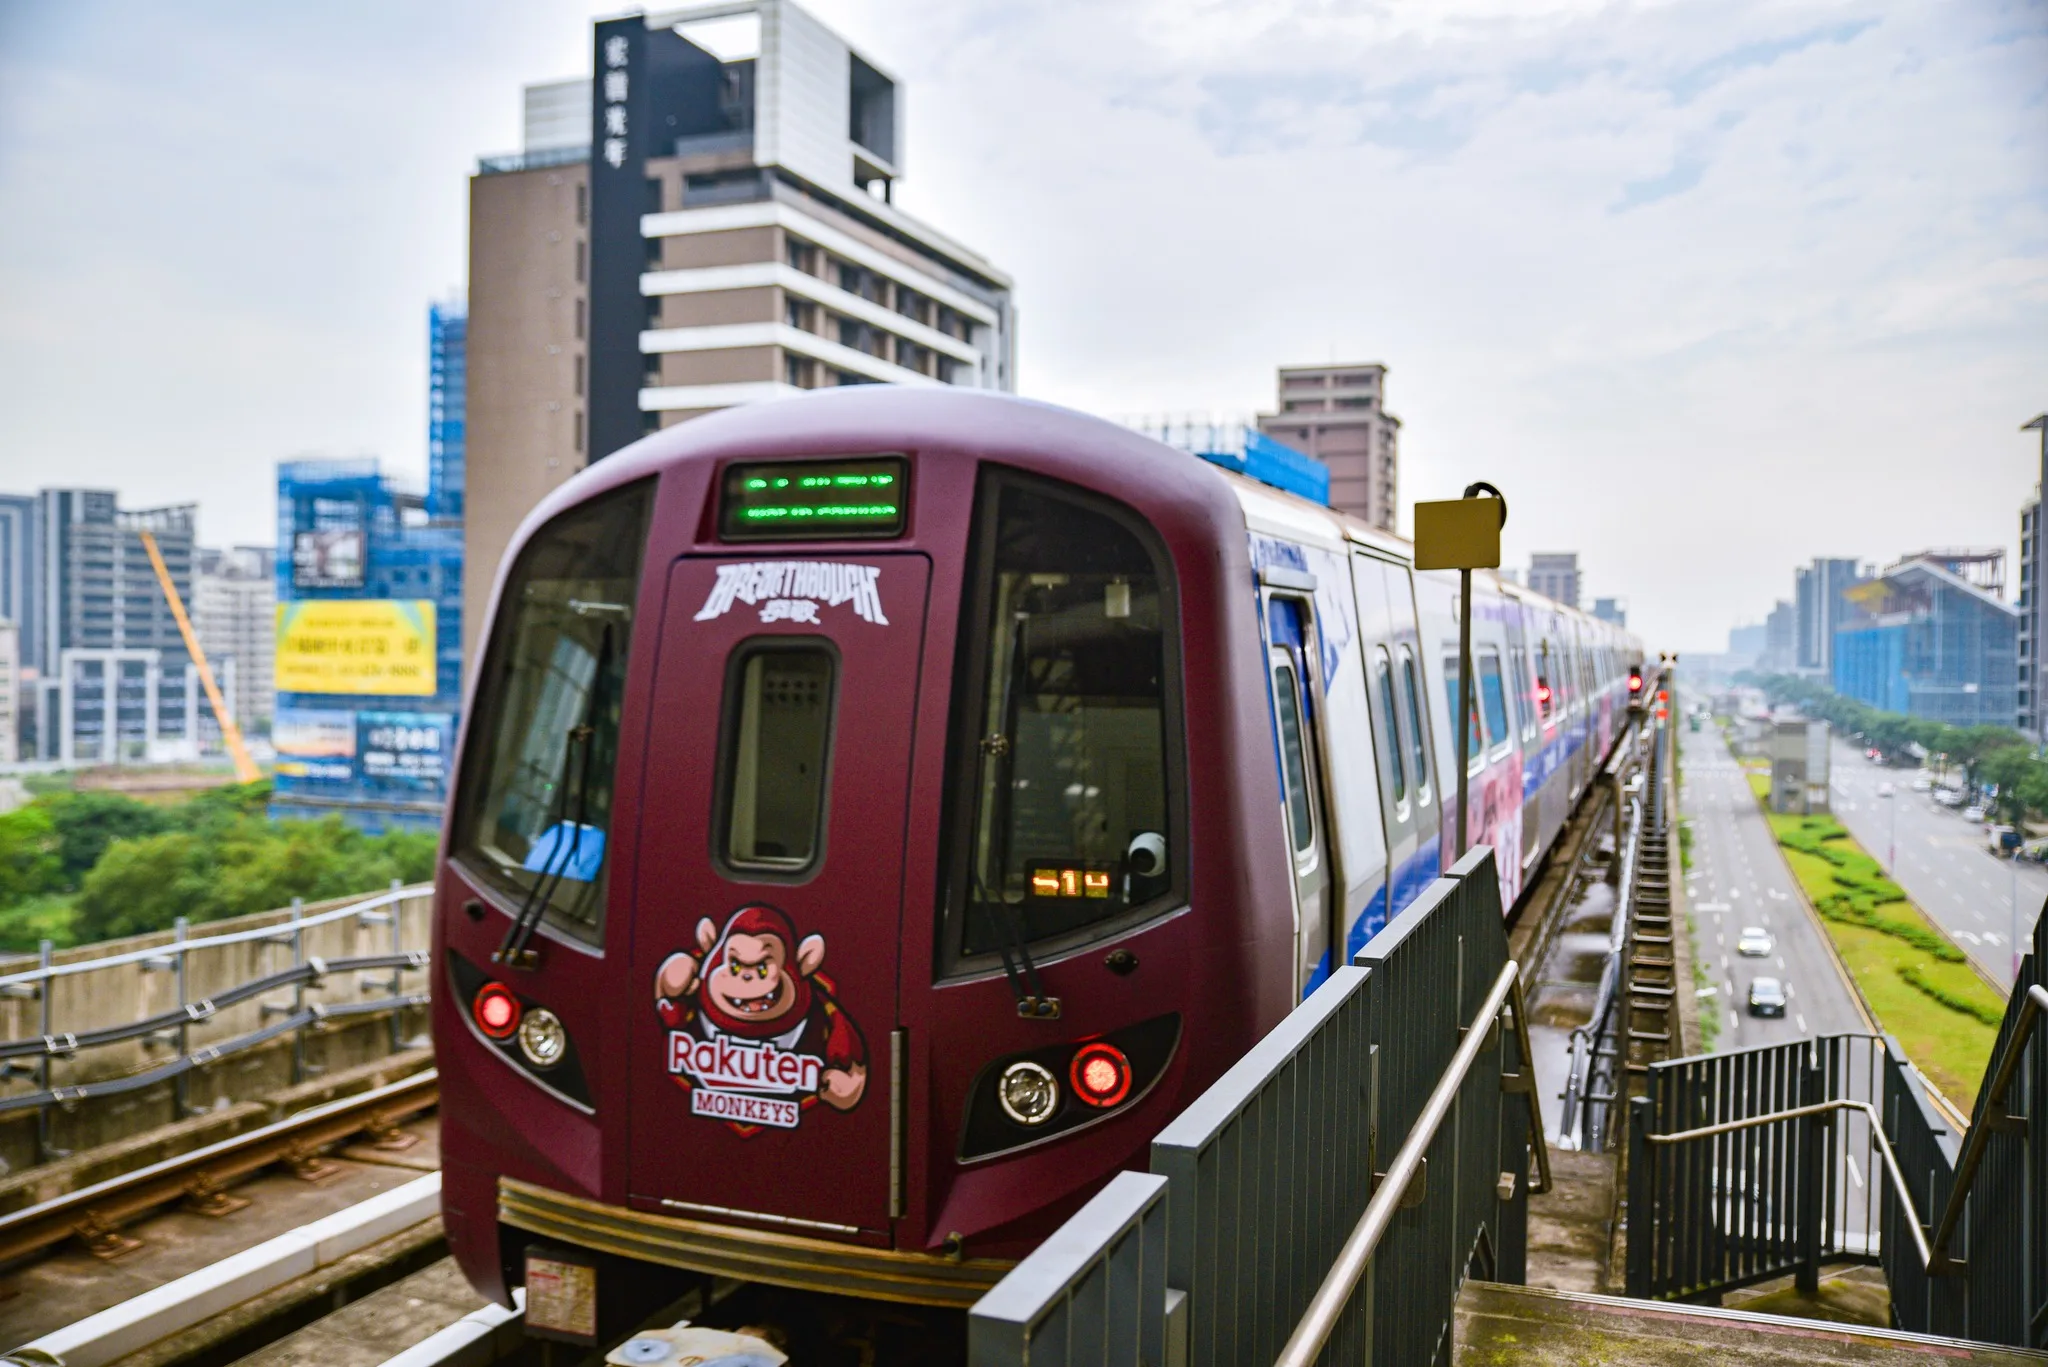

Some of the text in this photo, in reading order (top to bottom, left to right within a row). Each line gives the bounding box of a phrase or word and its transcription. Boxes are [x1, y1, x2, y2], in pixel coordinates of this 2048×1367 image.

[694, 561, 889, 626] BREAKTHROUGH
[670, 1033, 823, 1088] Rakuten
[695, 1092, 798, 1124] MONKEYS
